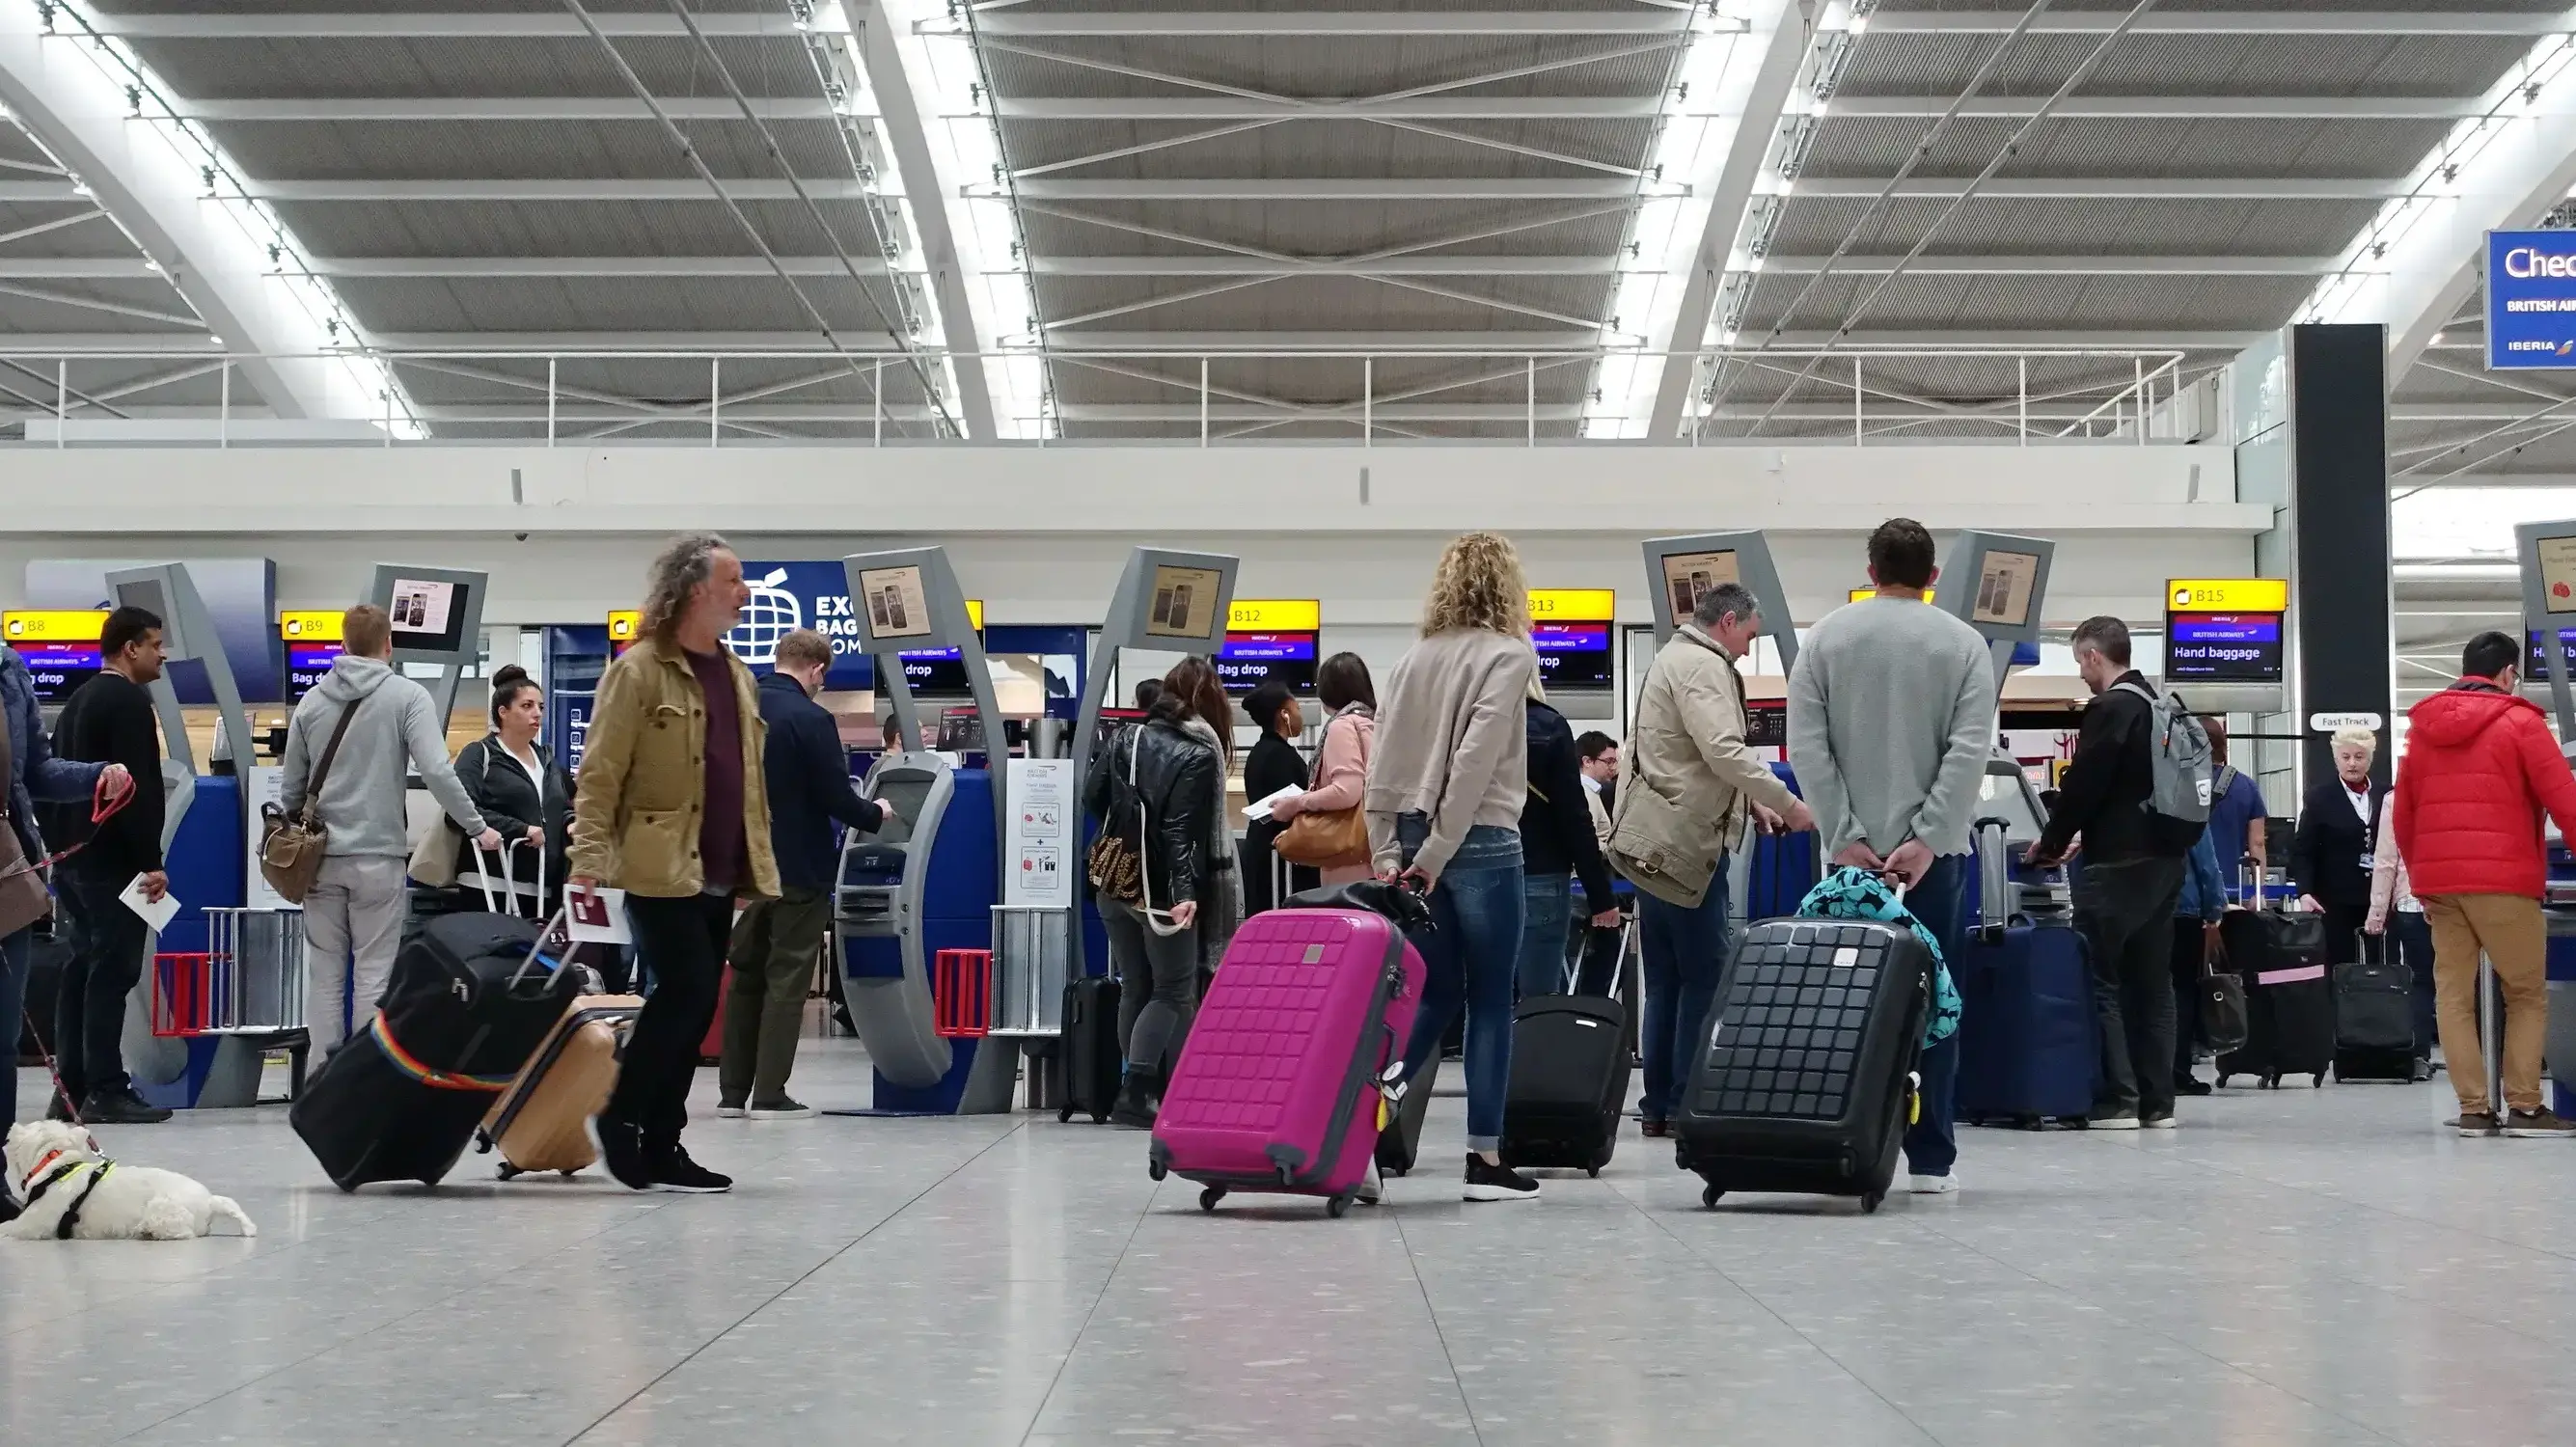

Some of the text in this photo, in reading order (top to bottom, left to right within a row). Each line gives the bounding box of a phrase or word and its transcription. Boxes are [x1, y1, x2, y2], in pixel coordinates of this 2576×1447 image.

[2507, 301, 2556, 312] BRITISH
[2508, 341, 2555, 351] IBERIA
[2196, 589, 2224, 602] B15
[816, 596, 854, 616] EX
[1234, 610, 1261, 622] B12
[28, 620, 44, 632] B8
[306, 620, 322, 632] B9
[2175, 646, 2261, 660] Hand baggage
[905, 664, 932, 677] drop
[1218, 664, 1268, 677] Bag drop
[38, 672, 65, 686] drop
[292, 673, 314, 686] Bag
[2322, 718, 2370, 726] Fast Track
